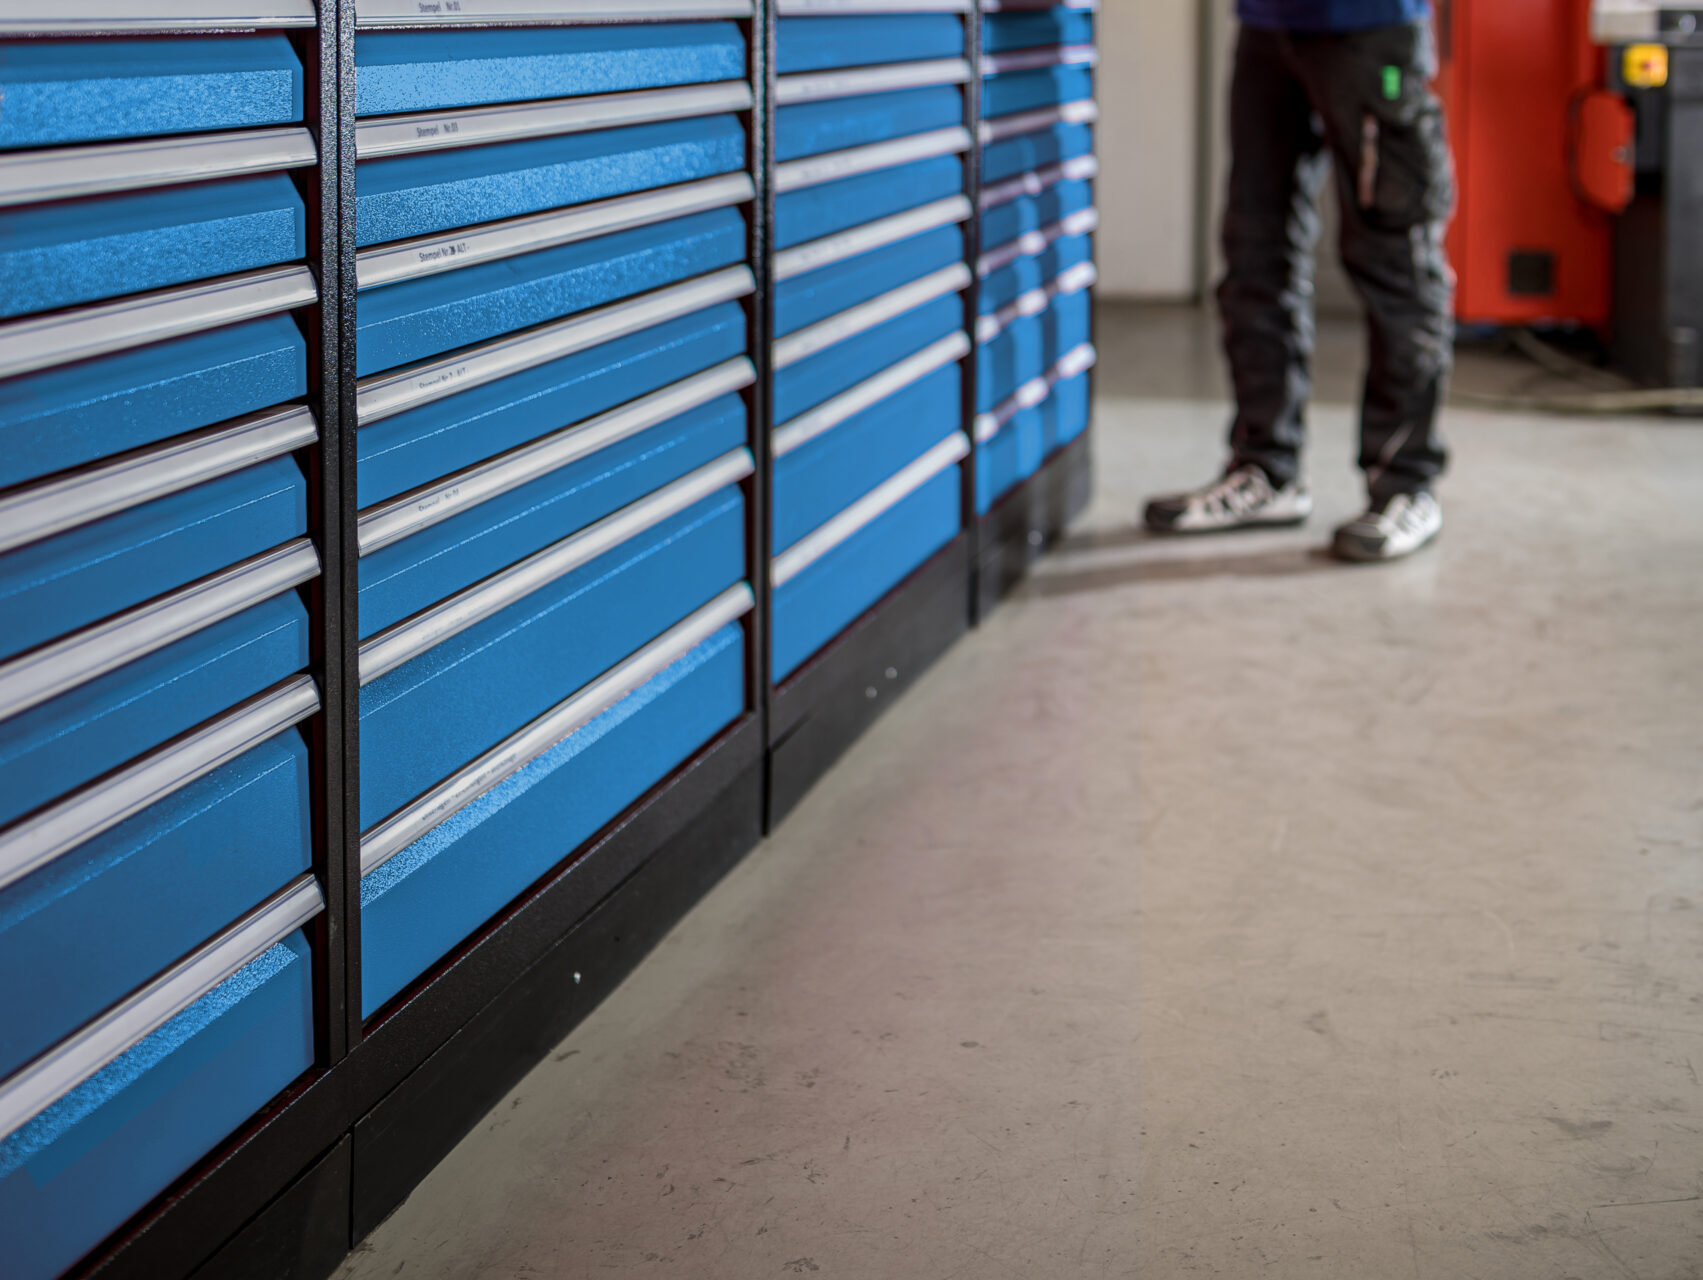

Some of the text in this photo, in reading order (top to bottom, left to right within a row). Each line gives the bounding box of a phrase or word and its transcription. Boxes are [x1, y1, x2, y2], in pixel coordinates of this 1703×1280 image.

[419, 0, 441, 13] Stempel
[416, 123, 439, 138] Stempel
[419, 248, 441, 262] Stempel
